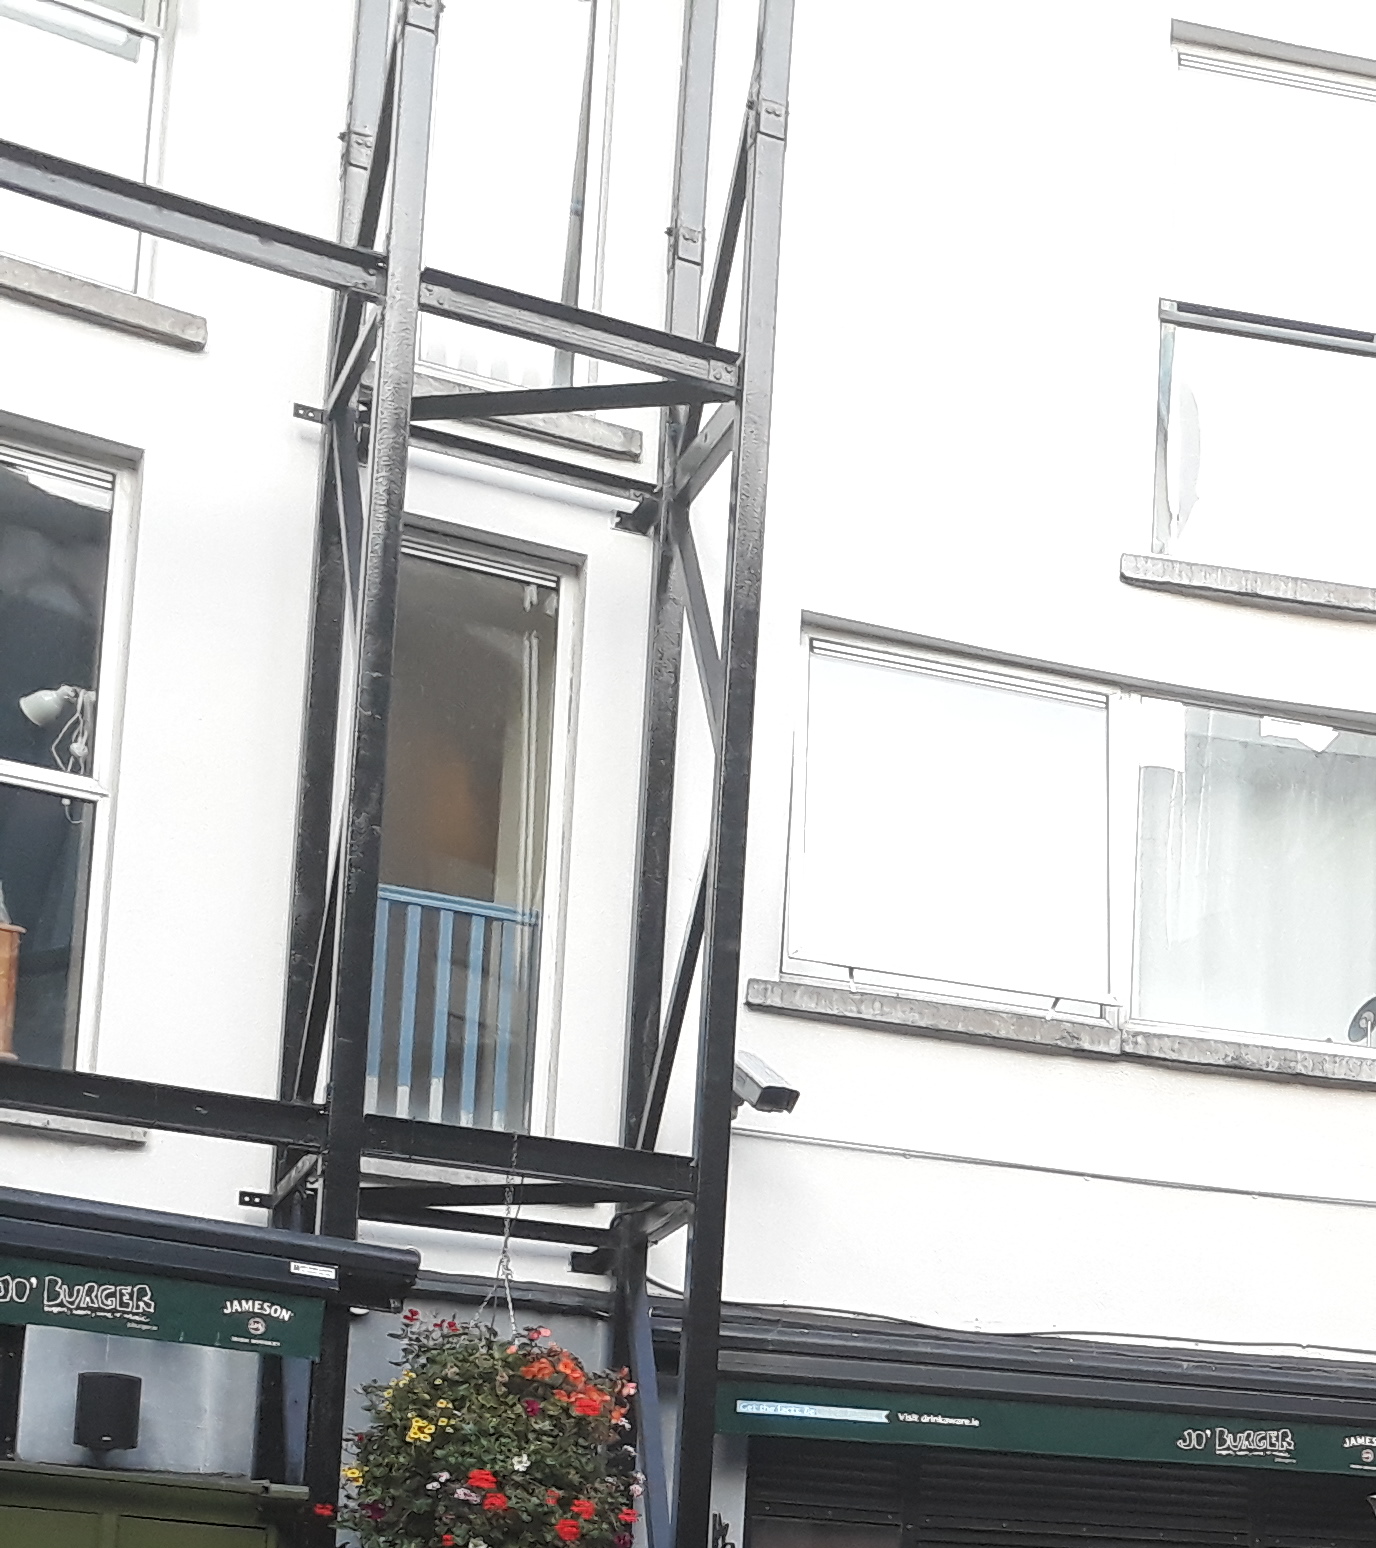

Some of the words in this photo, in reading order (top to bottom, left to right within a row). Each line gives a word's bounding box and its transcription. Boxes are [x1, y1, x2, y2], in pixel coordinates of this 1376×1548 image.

[43, 1275, 155, 1314] BURGER
[223, 1299, 293, 1322] JAMESON
[1176, 1428, 1211, 1450] JO'
[1215, 1427, 1295, 1451] BURGER
